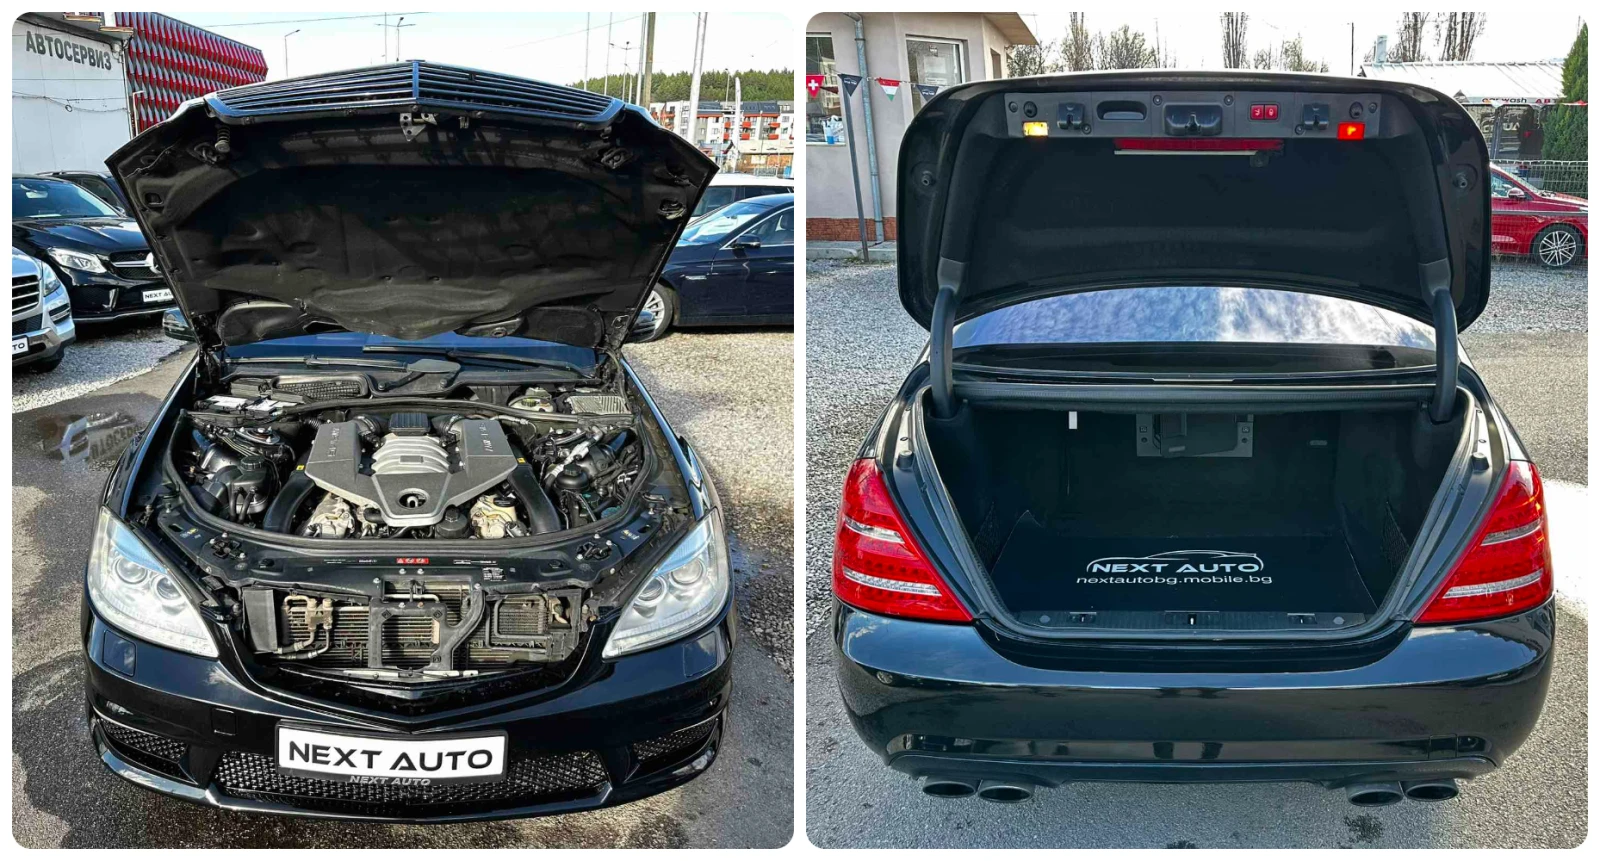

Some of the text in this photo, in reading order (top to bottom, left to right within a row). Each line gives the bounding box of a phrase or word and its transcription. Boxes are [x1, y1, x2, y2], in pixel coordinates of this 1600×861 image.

[26, 30, 112, 71] АВТОСЕРВИЗ
[1092, 563, 1260, 573] NEXT AUTO
[1076, 575, 1273, 585] nextautobg.mobile.bg
[289, 740, 493, 772] NEXT AUTO
[349, 775, 431, 786] NEXT AUTO
